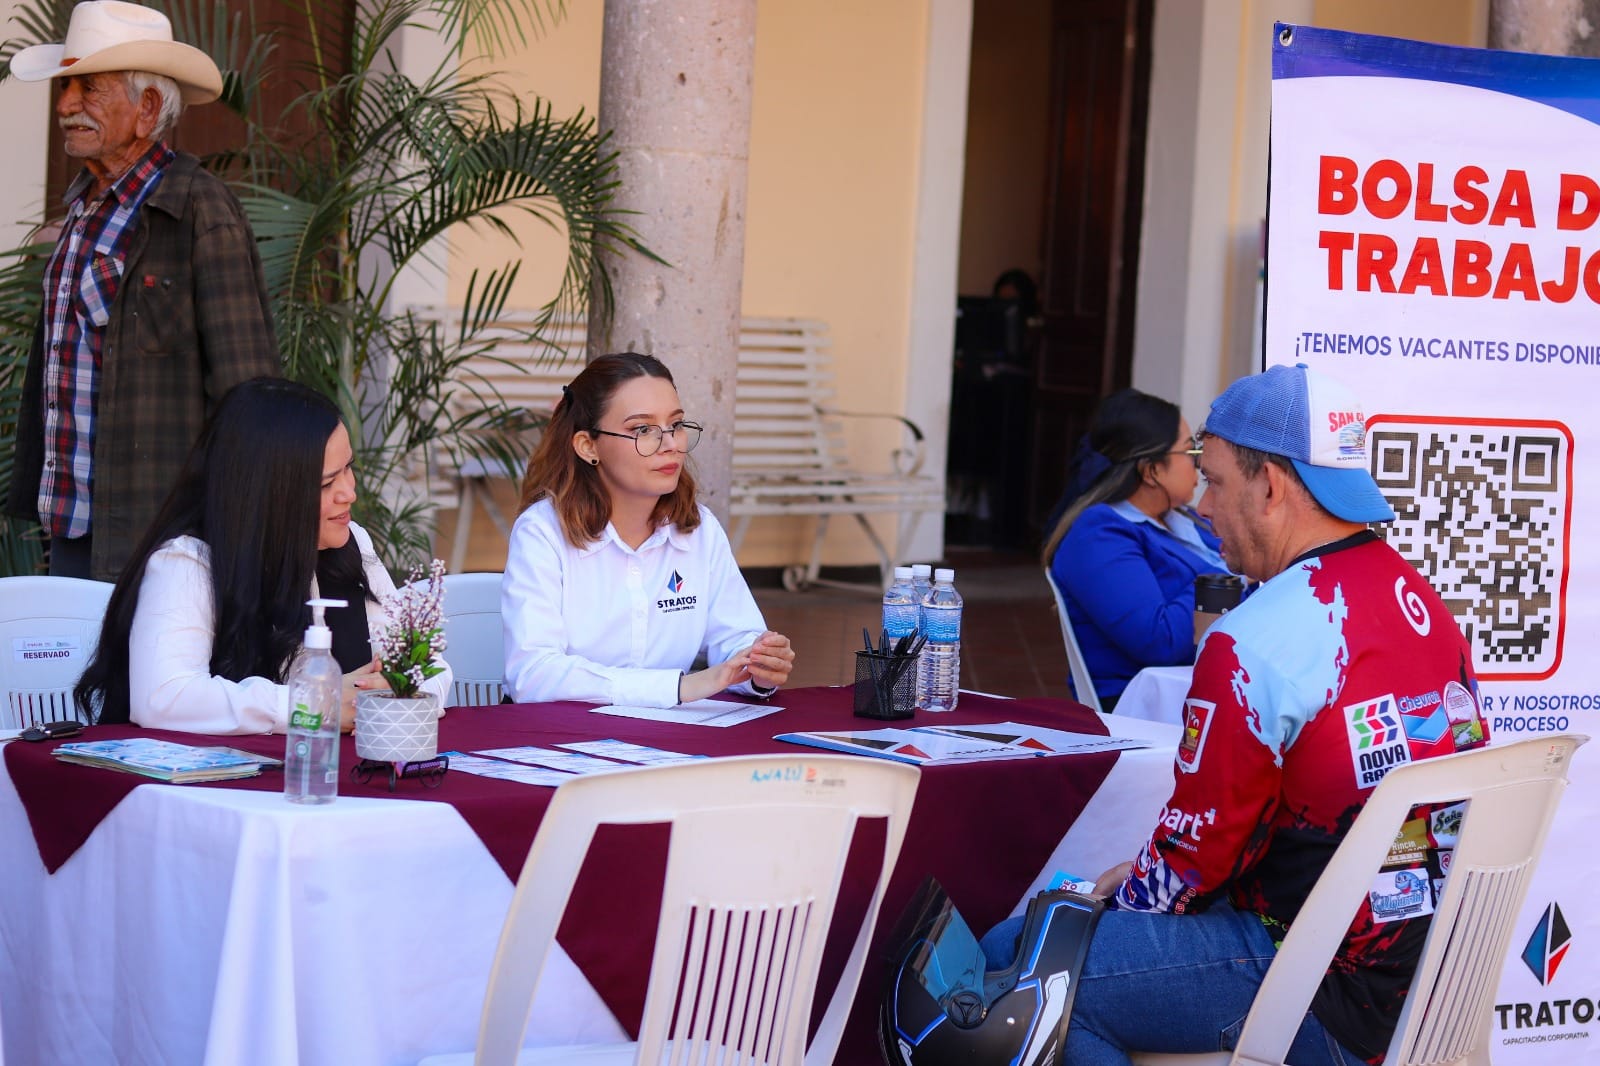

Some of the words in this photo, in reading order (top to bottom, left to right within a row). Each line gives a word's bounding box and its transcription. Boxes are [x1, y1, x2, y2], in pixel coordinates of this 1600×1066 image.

[1317, 155, 1536, 228] BOLSA
[1295, 332, 1392, 357] ¡TENEMOS
[1398, 336, 1509, 361] VACANTES
[1328, 411, 1354, 432] SAN
[657, 595, 697, 609] STRATOS
[23, 651, 70, 660] RESERVADO
[1398, 690, 1440, 712] Chevron
[1499, 696, 1510, 711] Y
[292, 713, 319, 727] Britz
[1493, 716, 1569, 732] PROCESO
[1359, 743, 1407, 772] NOVA
[1494, 997, 1600, 1031] TRATO
[1547, 1031, 1590, 1042] CORPORATIVA
